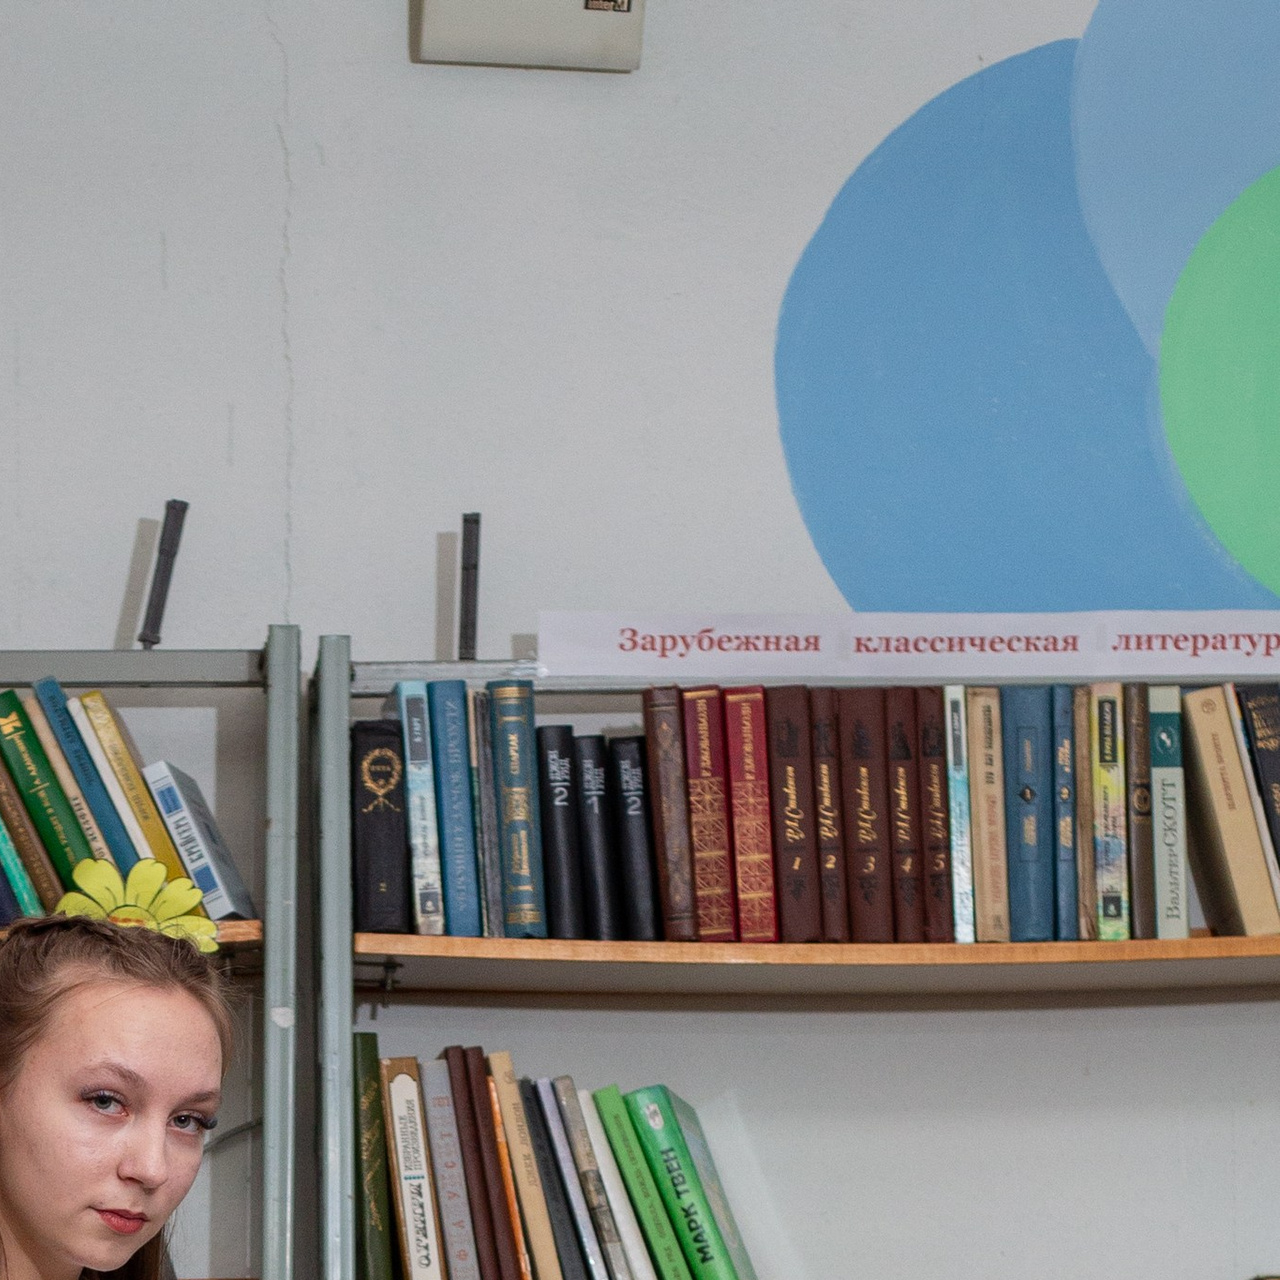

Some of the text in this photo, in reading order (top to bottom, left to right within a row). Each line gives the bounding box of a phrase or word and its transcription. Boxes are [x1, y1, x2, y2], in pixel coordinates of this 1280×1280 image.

[619, 627, 1280, 660] Зарубежная классическая литератур
[553, 786, 570, 806] 2
[586, 795, 599, 815] 1
[626, 796, 642, 816] 2
[399, 1115, 413, 1171] ИЗБРАННЫЕ
[405, 1099, 422, 1171] ПРОИЗВЕДЕНИЯ
[661, 1147, 714, 1264] МАРК ТВЕН
